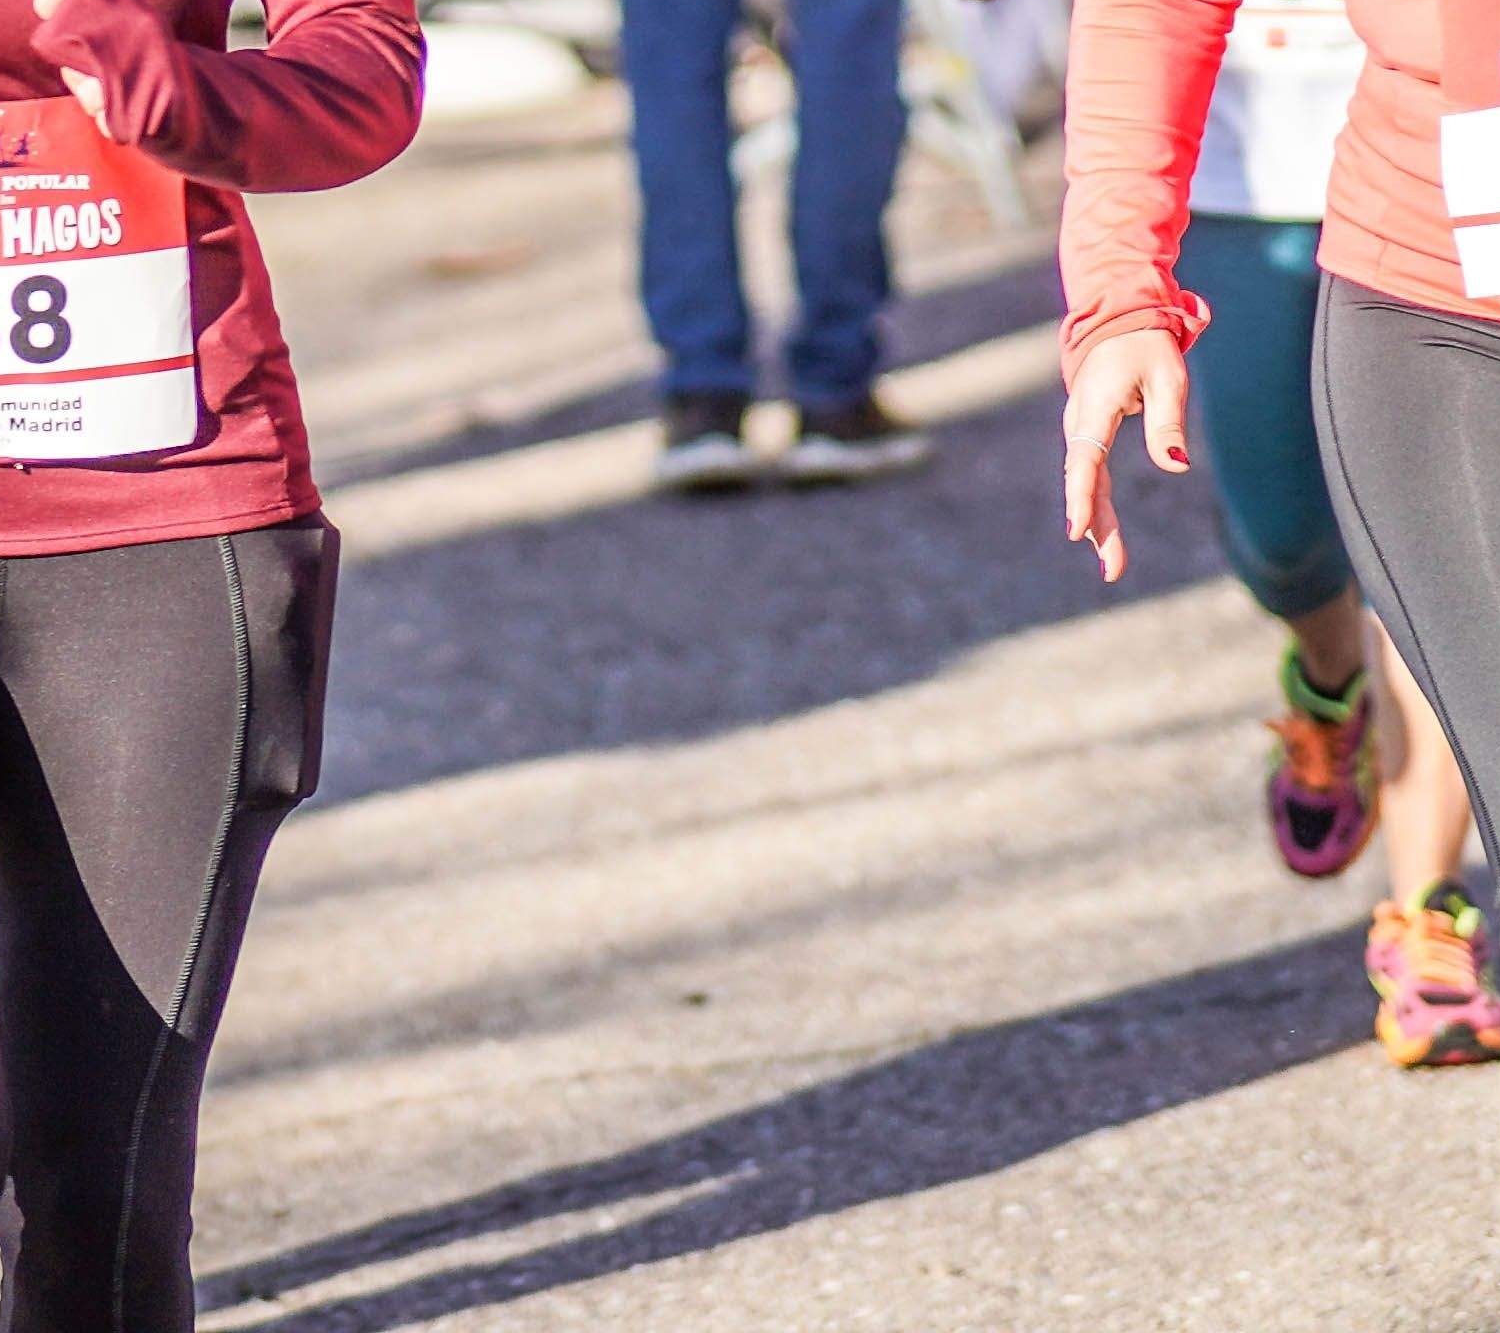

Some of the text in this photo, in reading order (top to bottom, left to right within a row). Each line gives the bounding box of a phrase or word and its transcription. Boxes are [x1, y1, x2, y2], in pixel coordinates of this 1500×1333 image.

[0, 174, 91, 192] POPULAR
[0, 198, 123, 258] MAGOS
[9, 416, 84, 432] Madrid
